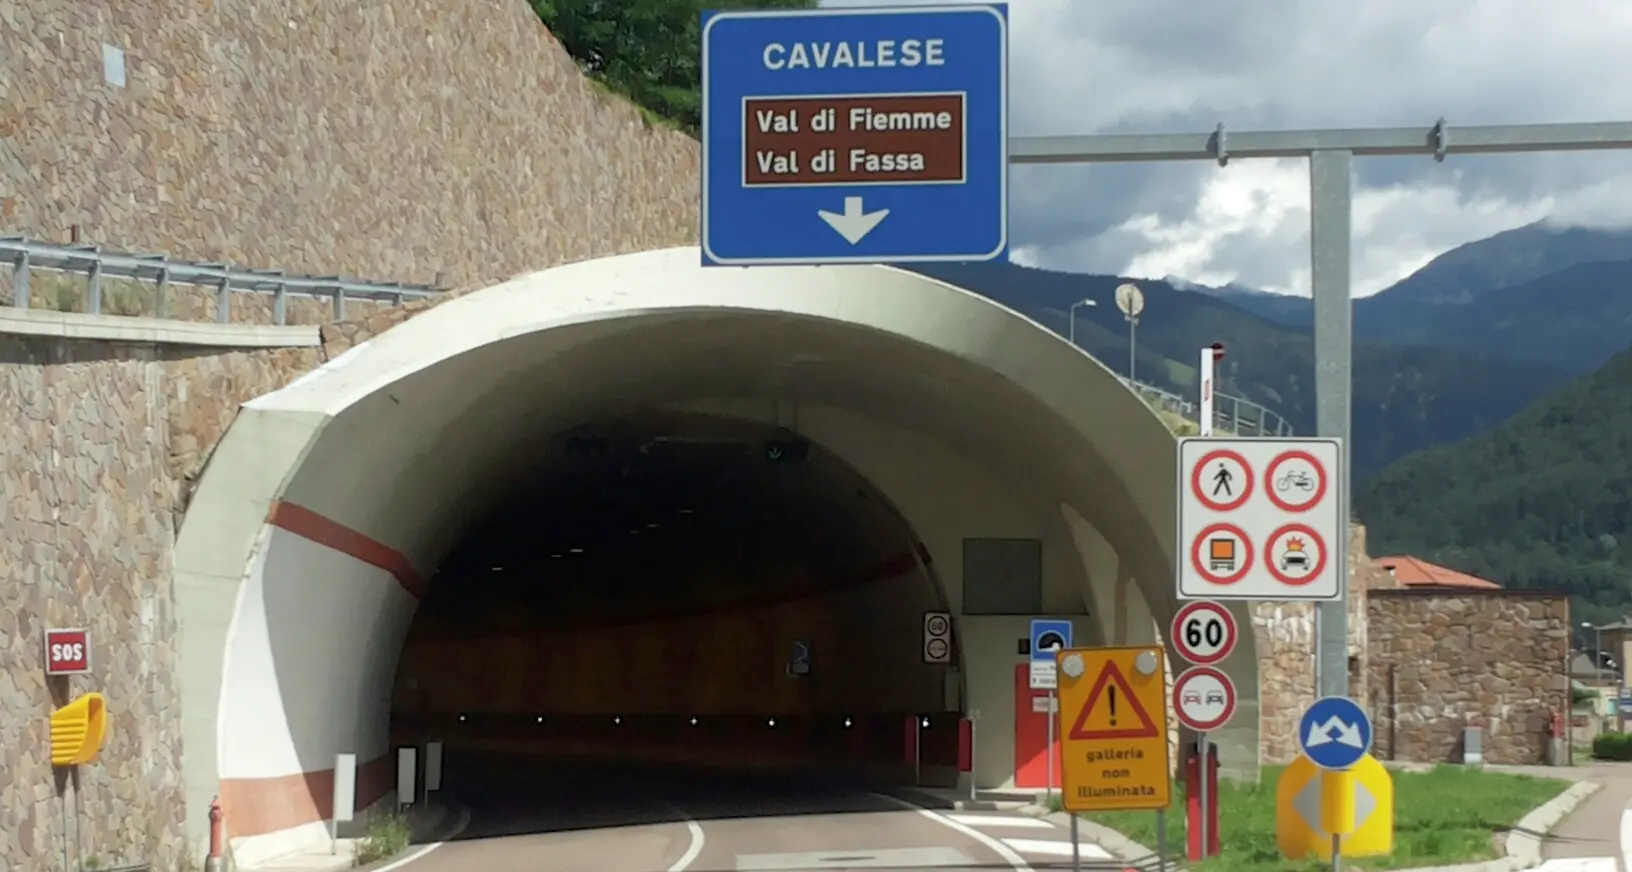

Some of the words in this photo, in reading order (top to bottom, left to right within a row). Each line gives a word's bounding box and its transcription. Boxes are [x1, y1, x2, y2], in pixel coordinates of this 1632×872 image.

[763, 38, 945, 70] CAVALESE
[756, 109, 799, 133] Val
[810, 108, 836, 132] di
[849, 107, 952, 131] Fiemme
[756, 150, 799, 174] Val
[810, 149, 836, 173] di
[849, 149, 925, 172] Fassa
[1186, 618, 1222, 647] 60
[52, 643, 83, 661] SOS
[1086, 747, 1144, 763] galleria
[1102, 769, 1130, 779] non
[1078, 785, 1156, 798] illuminata
